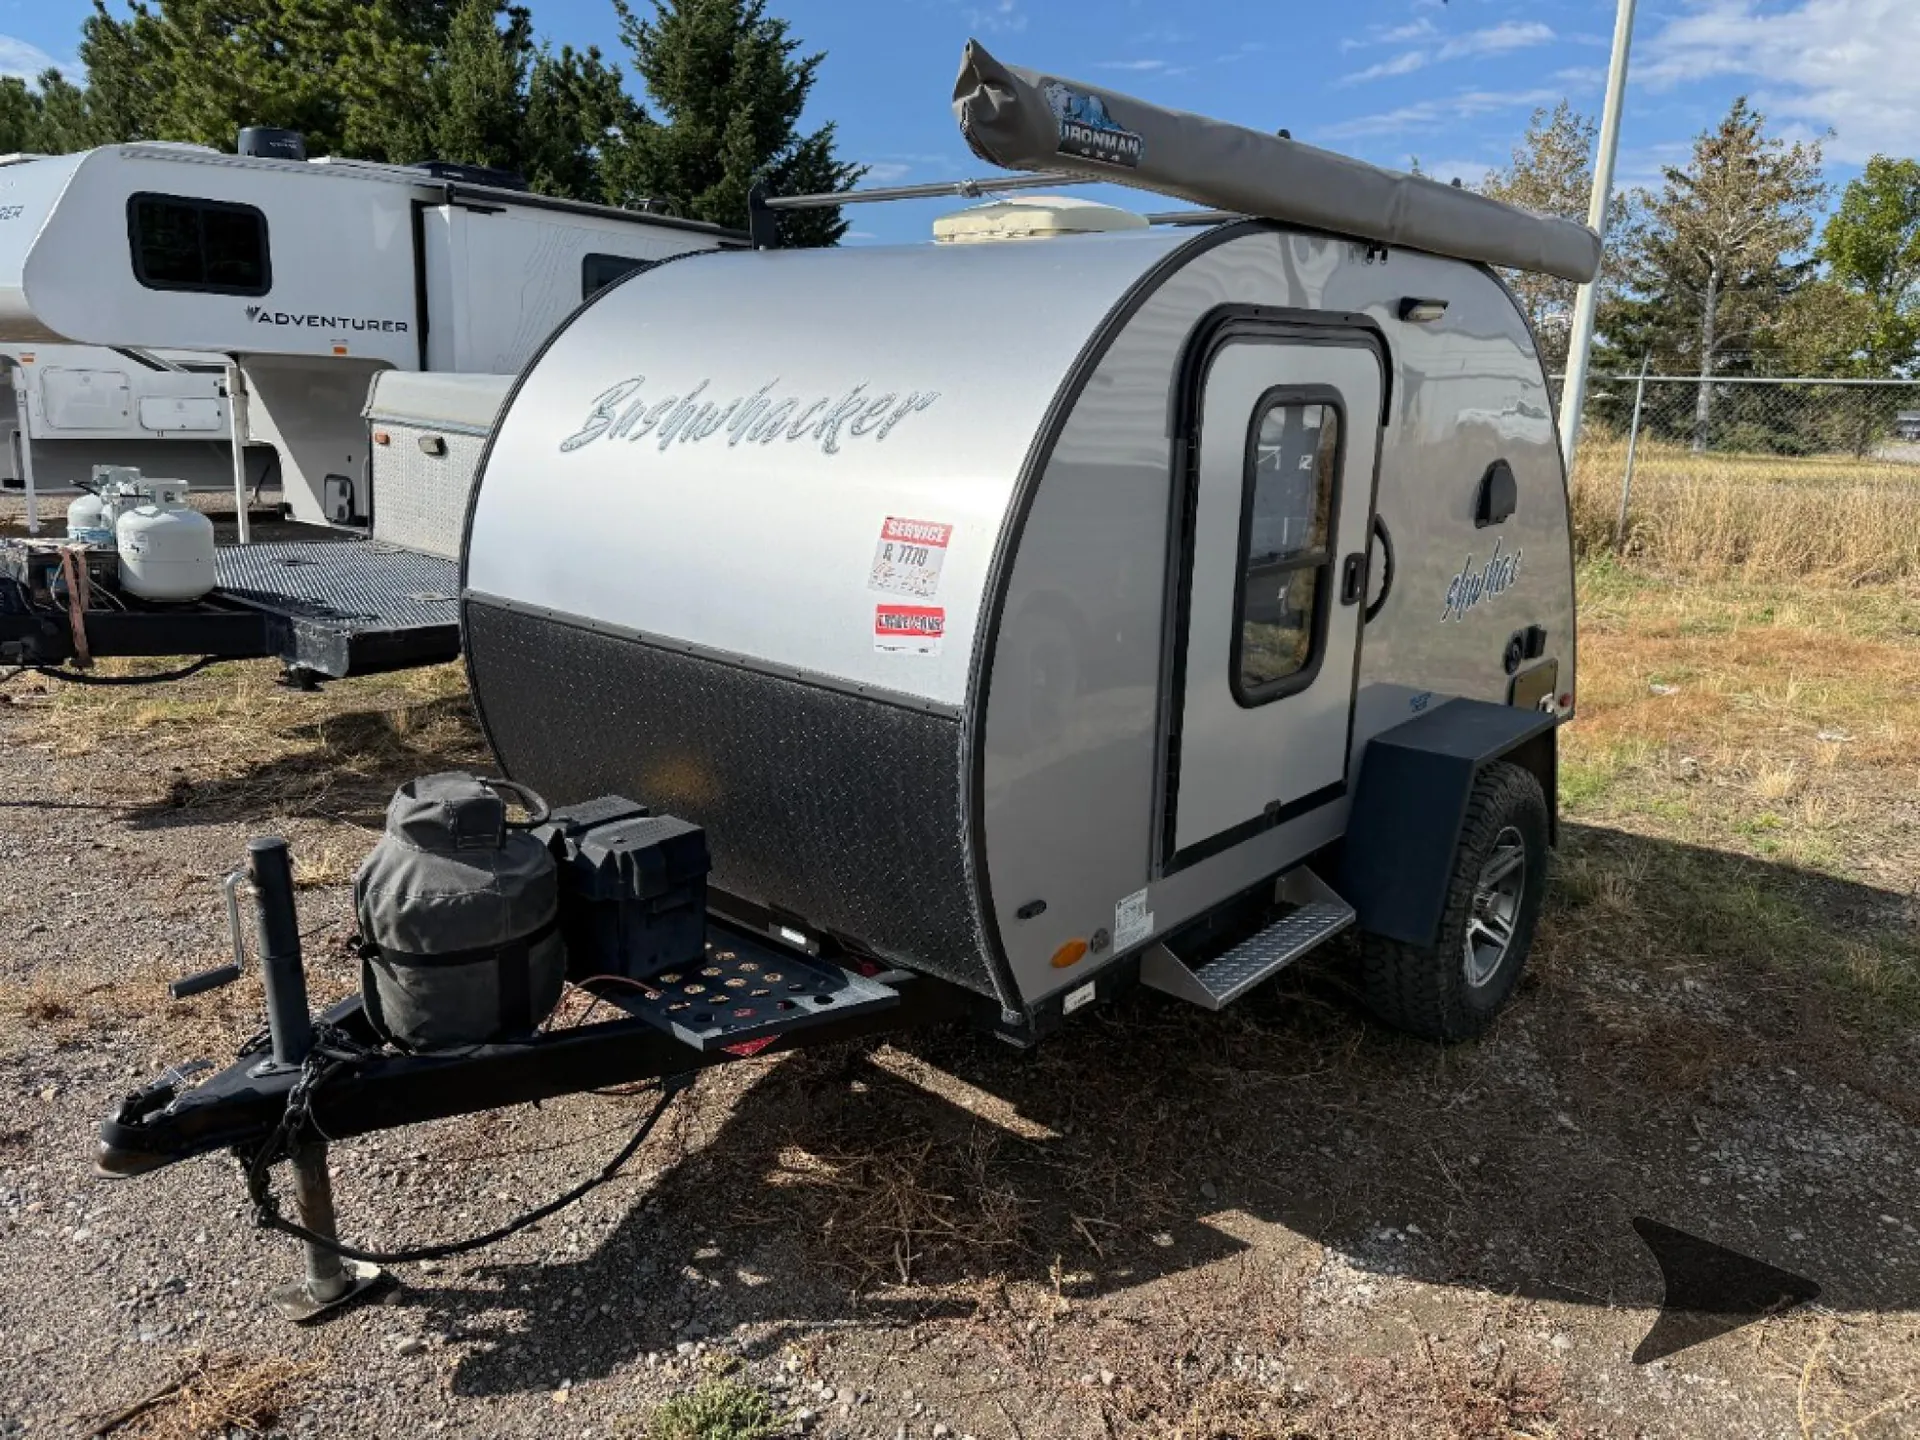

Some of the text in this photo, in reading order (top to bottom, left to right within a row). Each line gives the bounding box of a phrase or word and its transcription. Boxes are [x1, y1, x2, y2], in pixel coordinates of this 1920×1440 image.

[1063, 123, 1140, 156] IRONMAN
[257, 311, 409, 333] ADVENTURER
[886, 520, 947, 543] SERVICE
